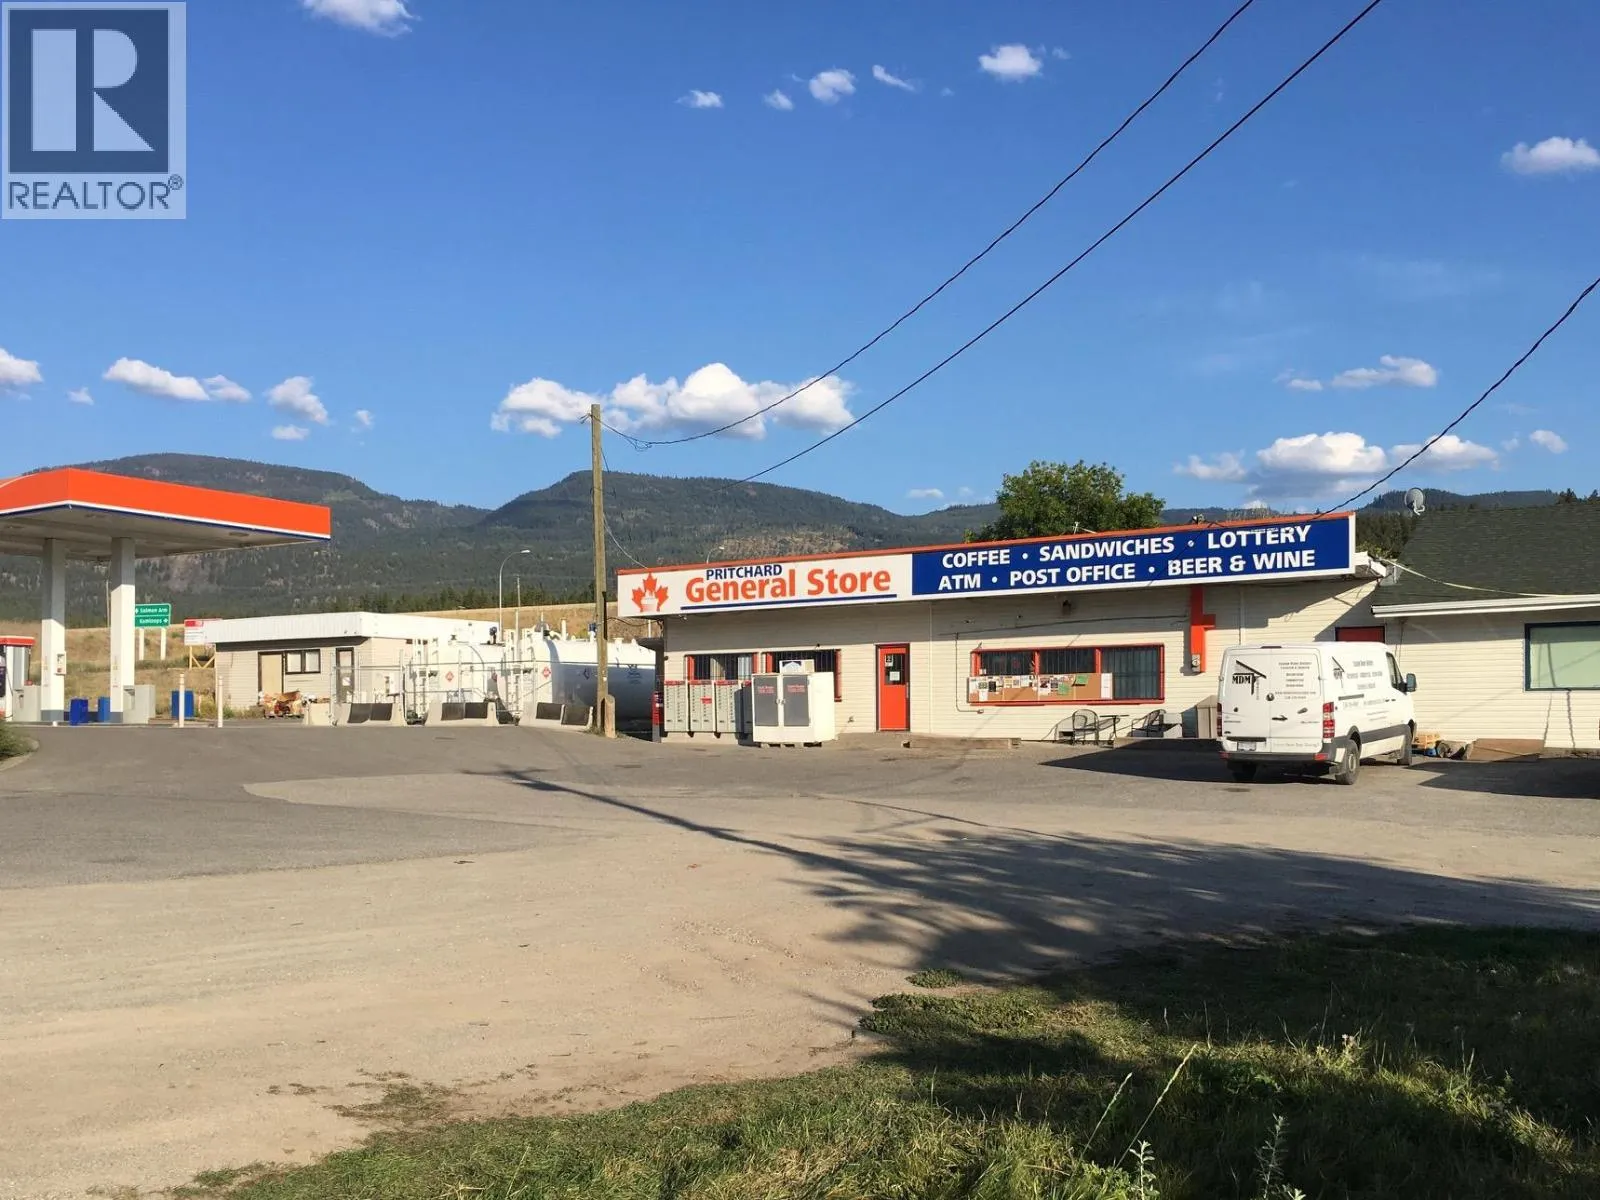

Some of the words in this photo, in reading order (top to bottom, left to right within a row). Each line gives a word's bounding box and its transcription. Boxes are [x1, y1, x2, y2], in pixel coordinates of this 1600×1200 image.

[942, 549, 1010, 569] COFFEE
[1039, 536, 1175, 562] SANDWICHES
[1207, 524, 1312, 549] LOTTERY
[685, 569, 796, 603] General
[807, 566, 891, 596] Store
[706, 564, 783, 581] PRITCHARD
[938, 573, 981, 591] ATM
[1010, 568, 1060, 586] POST
[1066, 563, 1136, 583] OFFICE
[1168, 556, 1223, 576] BEER
[1229, 555, 1246, 572] &
[1252, 549, 1316, 570] WINE
[1232, 675, 1251, 684] MDM
